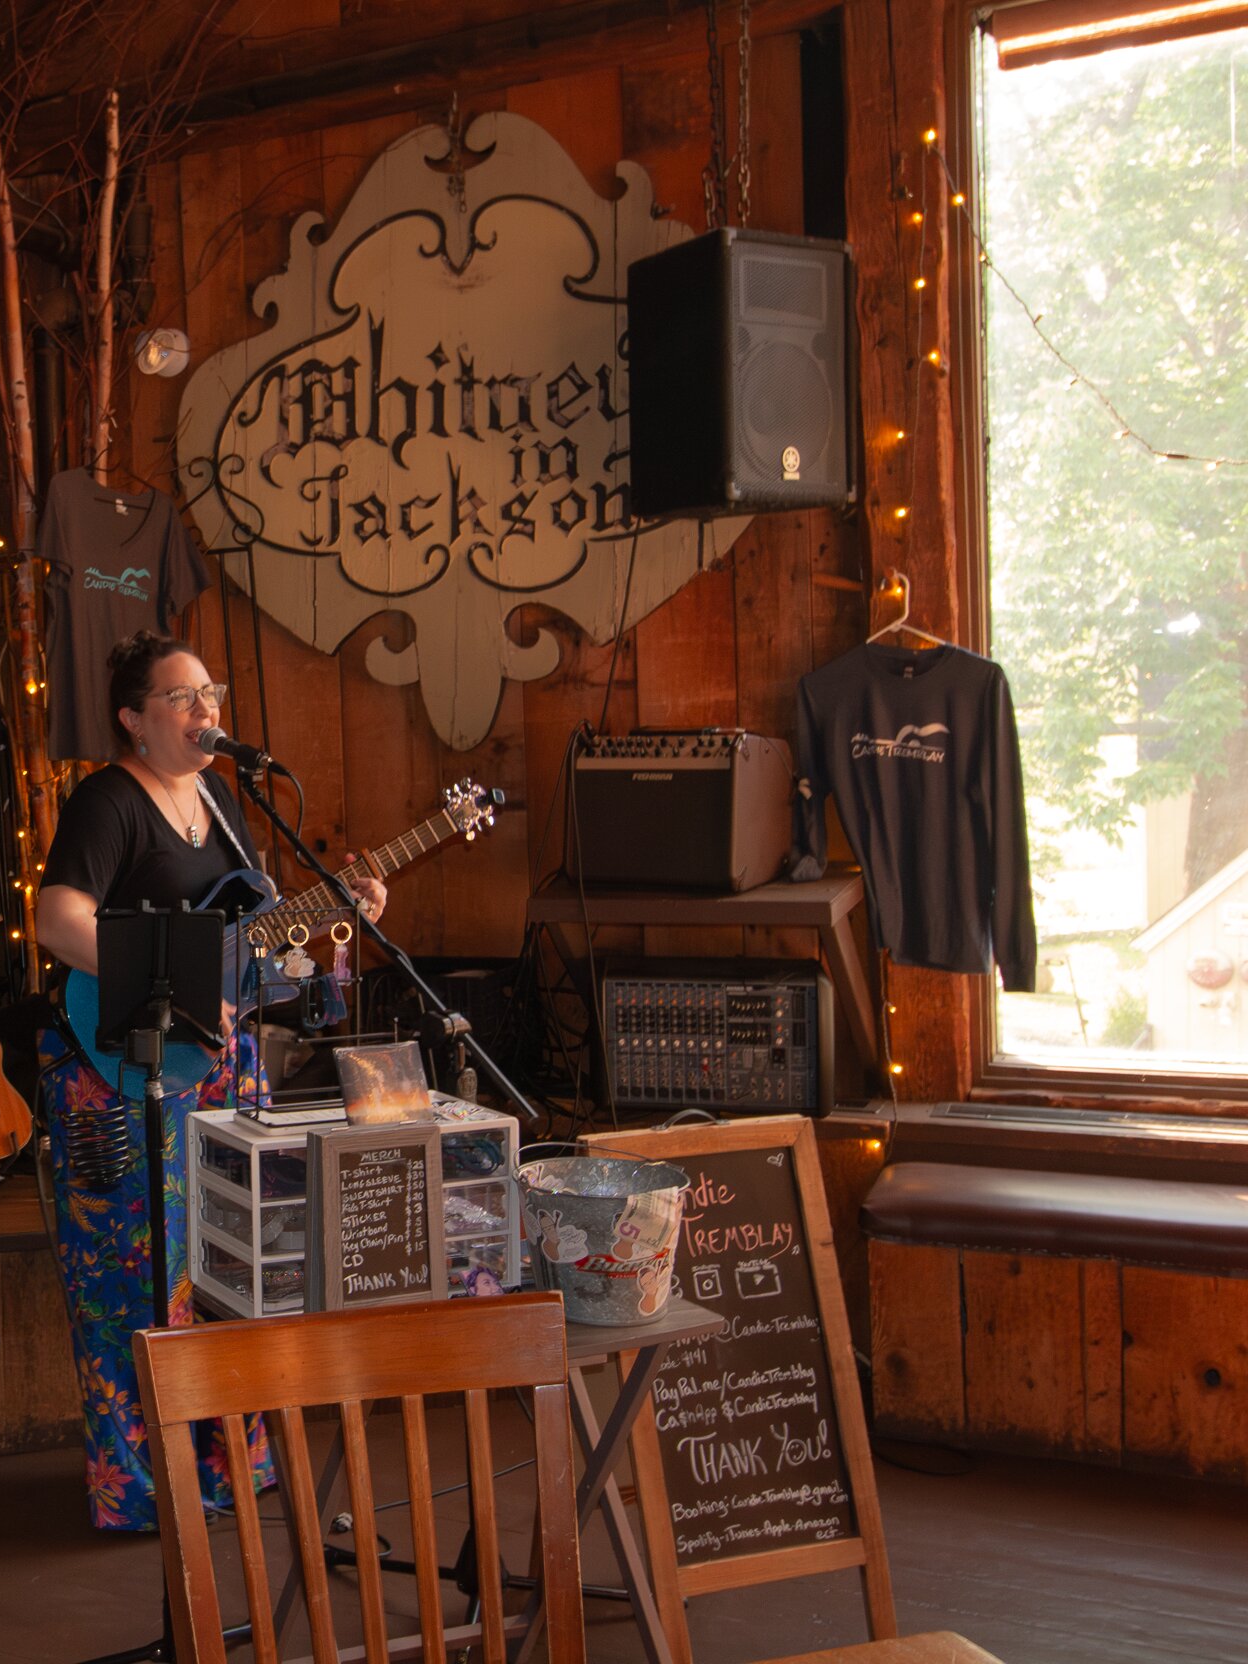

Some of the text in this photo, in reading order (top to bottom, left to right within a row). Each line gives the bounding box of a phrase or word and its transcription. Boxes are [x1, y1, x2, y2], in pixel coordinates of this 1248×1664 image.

[509, 429, 582, 488] in
[300, 452, 634, 555] Jackson
[360, 1148, 401, 1162] MERCH
[342, 1211, 387, 1228] STICKER
[341, 1222, 388, 1241] Wristband
[681, 1212, 793, 1261] TREMBLAY
[343, 1253, 364, 1268] CD
[343, 1272, 397, 1295] THANK
[676, 1431, 769, 1485] THANK
